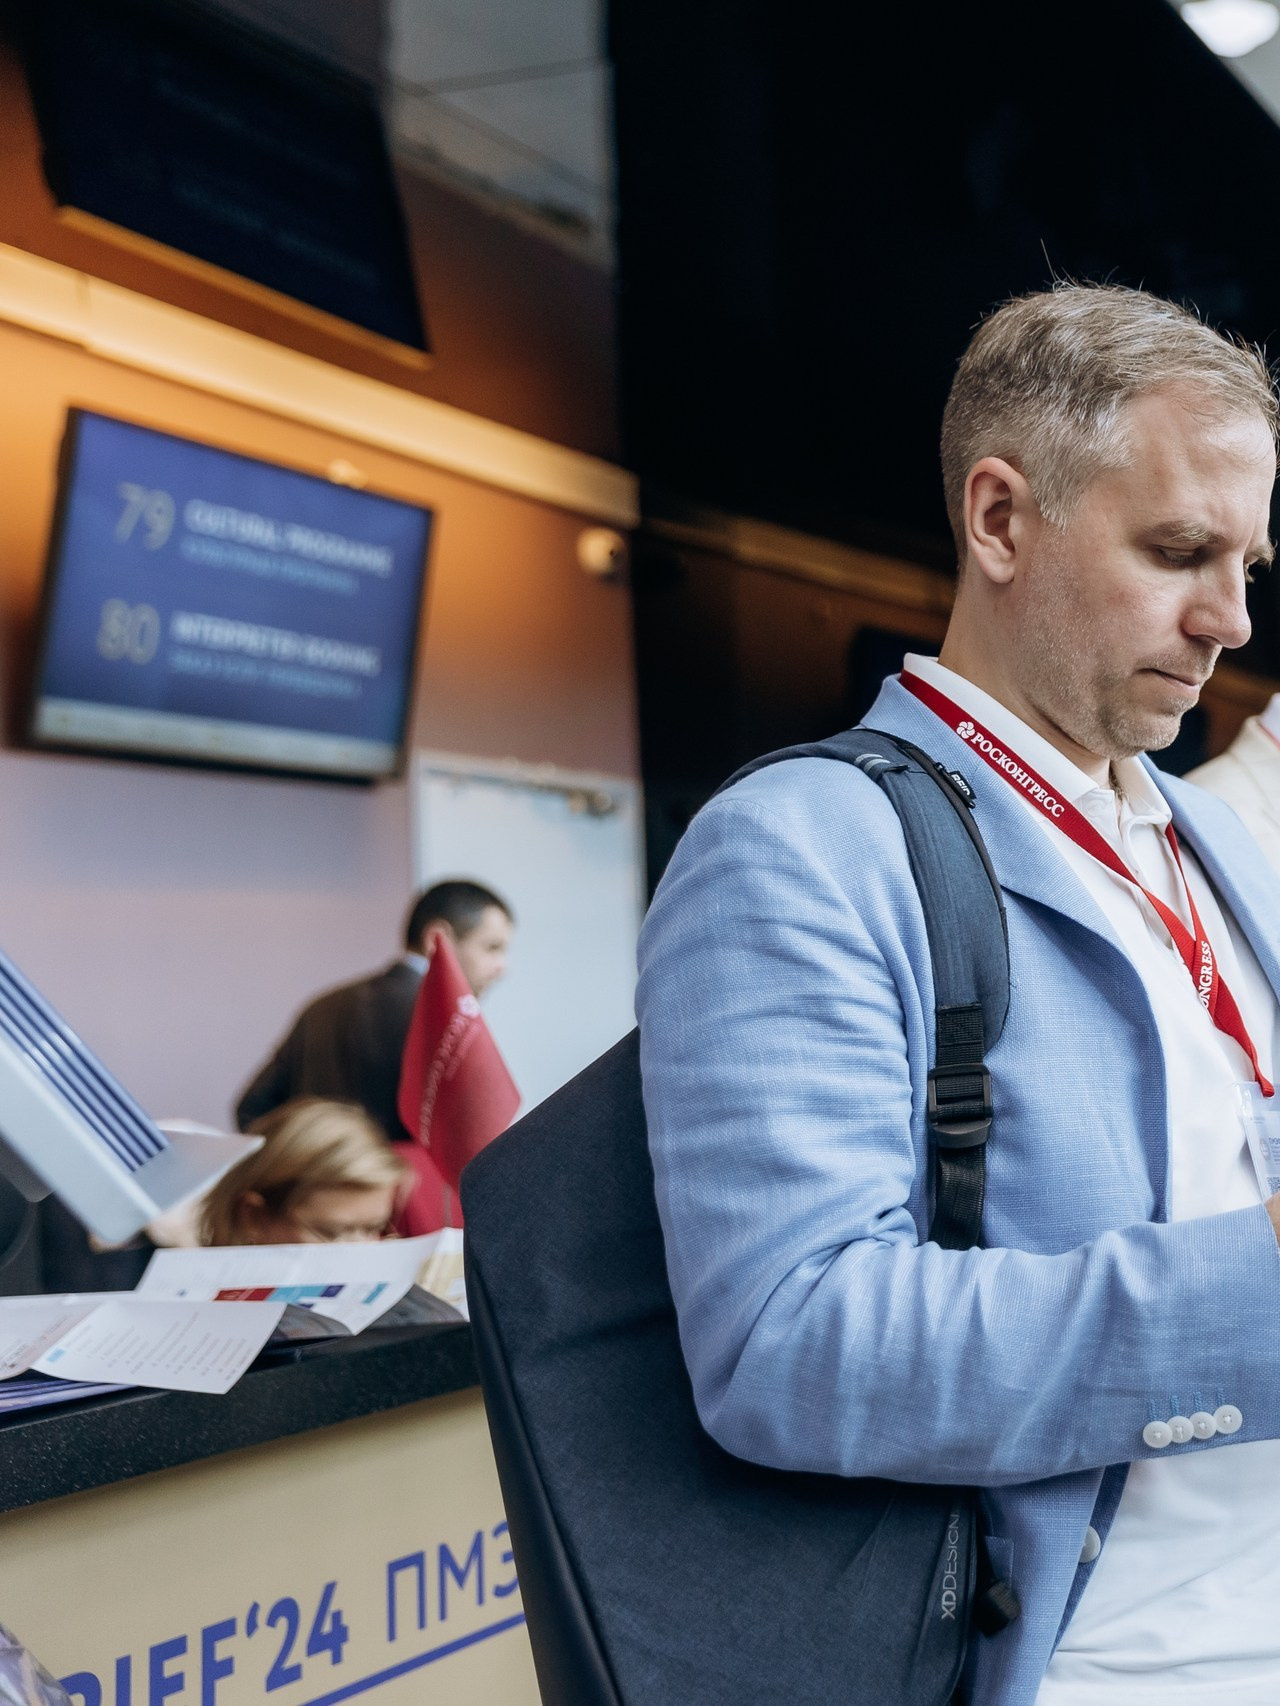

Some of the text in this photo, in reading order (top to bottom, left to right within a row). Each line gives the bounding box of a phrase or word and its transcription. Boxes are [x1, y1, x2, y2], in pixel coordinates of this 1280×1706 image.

[114, 481, 176, 550] 79
[97, 598, 160, 665] 80
[971, 732, 1065, 818] РОСКОНГРЕСС
